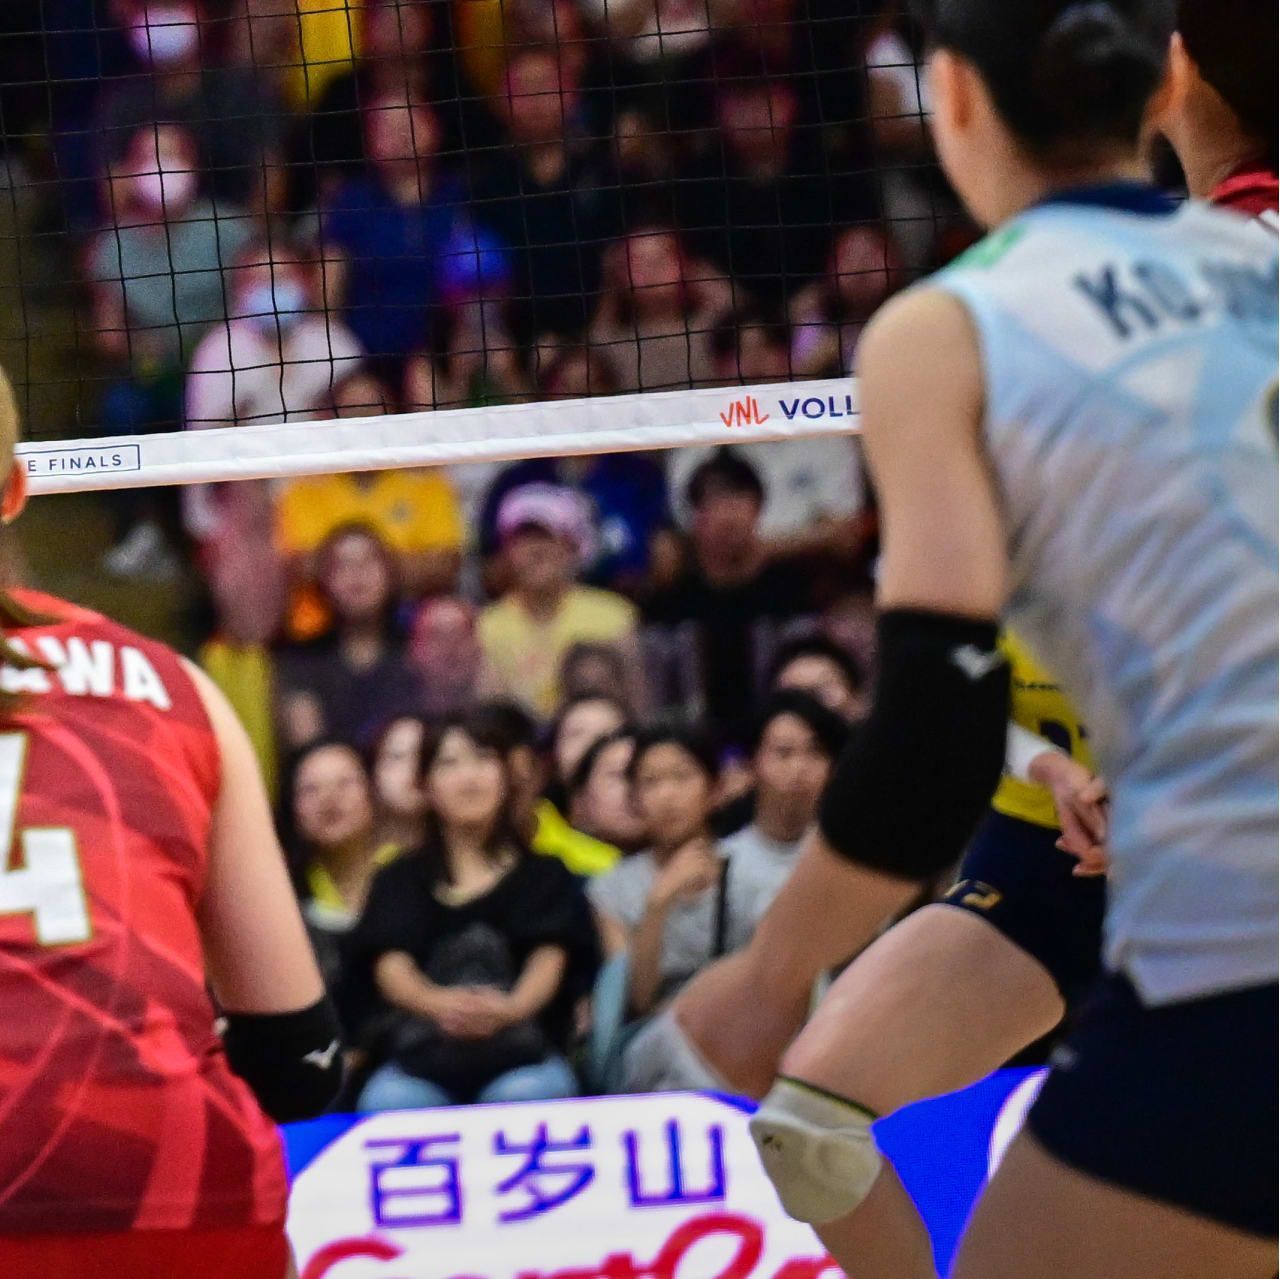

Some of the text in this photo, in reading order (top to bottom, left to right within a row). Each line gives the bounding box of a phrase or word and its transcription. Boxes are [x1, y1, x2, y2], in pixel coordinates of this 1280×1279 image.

[719, 394, 861, 428] VNL VOLL
[48, 453, 123, 471] FINALS
[363, 1116, 729, 1229] 百岁山
